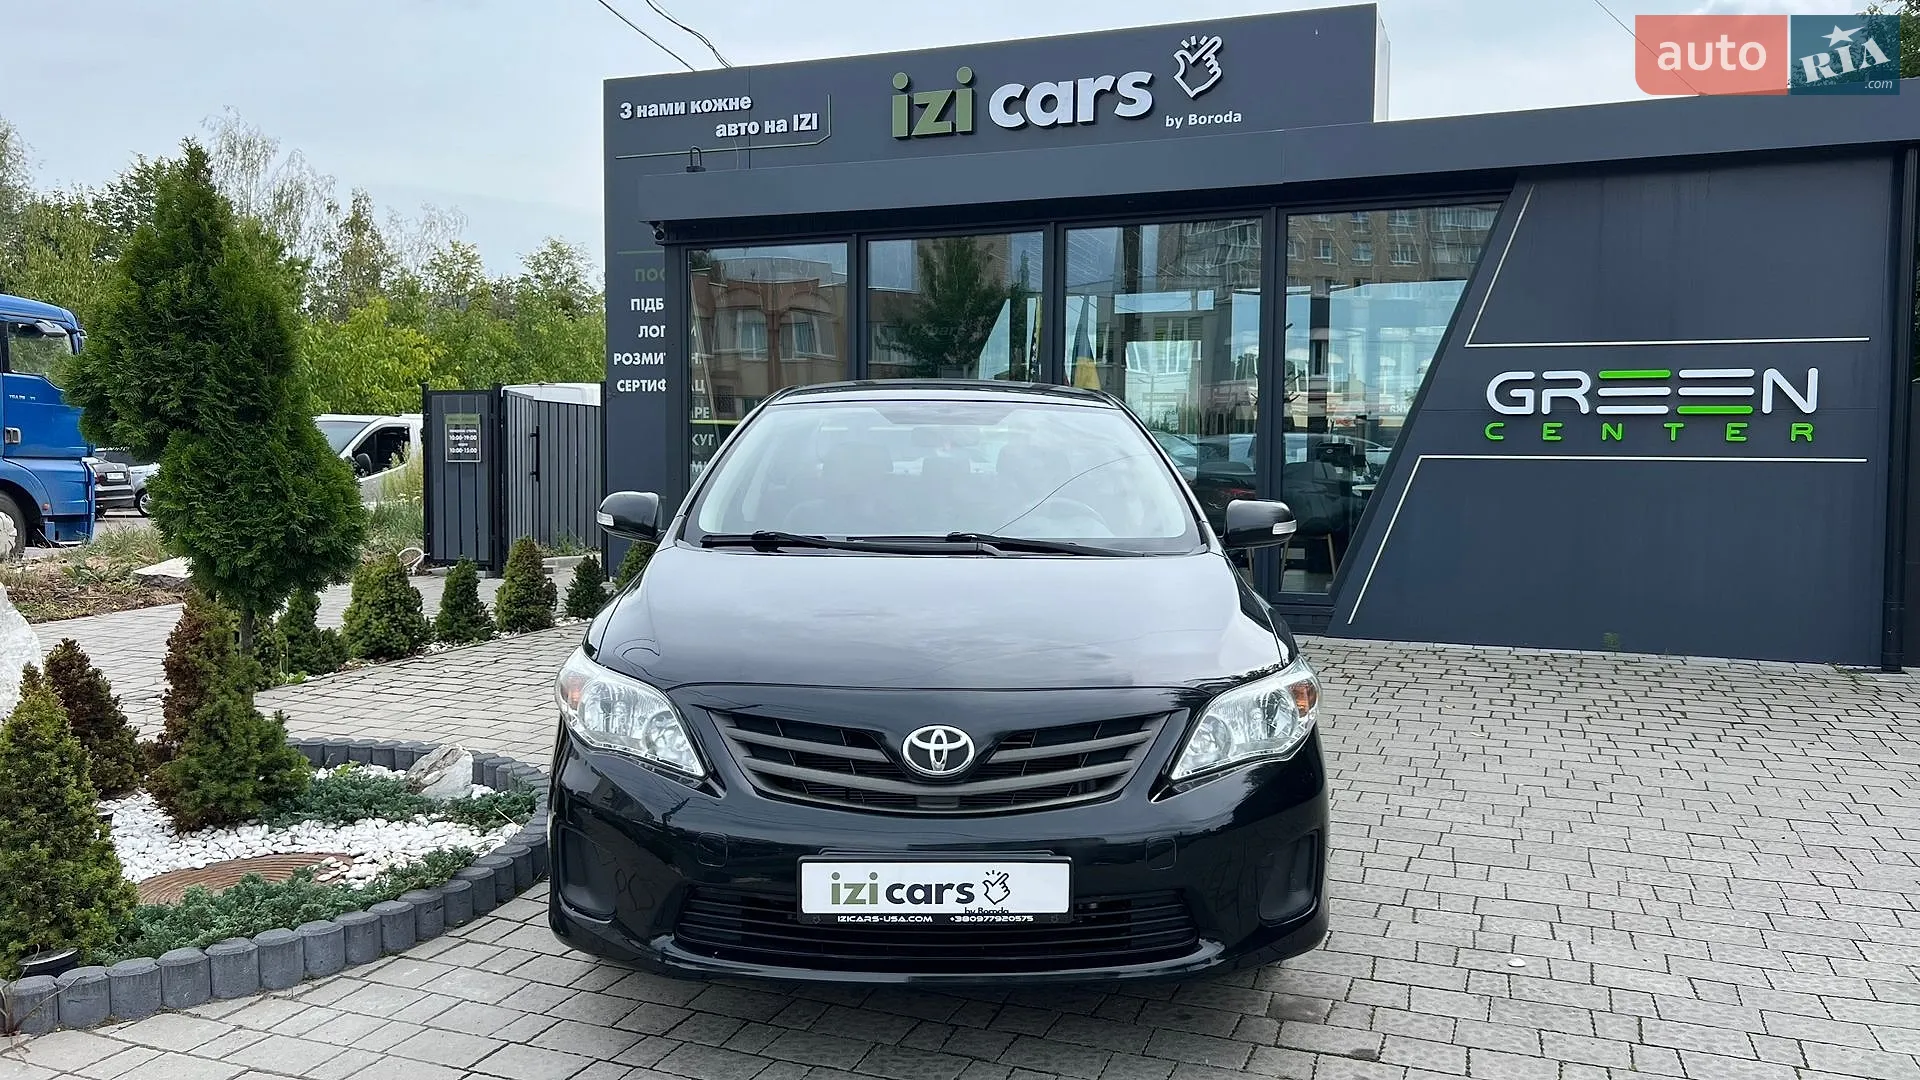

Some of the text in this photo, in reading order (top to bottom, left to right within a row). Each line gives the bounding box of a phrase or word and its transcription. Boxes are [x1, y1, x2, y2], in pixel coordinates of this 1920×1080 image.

[636, 101, 686, 118] нами
[690, 95, 752, 114] кожне
[891, 66, 1154, 138] izi cars
[715, 113, 819, 137] авто на IZI
[1164, 110, 1242, 128] by Boroda
[1486, 367, 1819, 415] GREEN
[1484, 422, 1814, 442] CENTER
[831, 871, 975, 905] izi cars
[837, 915, 1034, 923] IZICARS-USA.COM +380977920575
